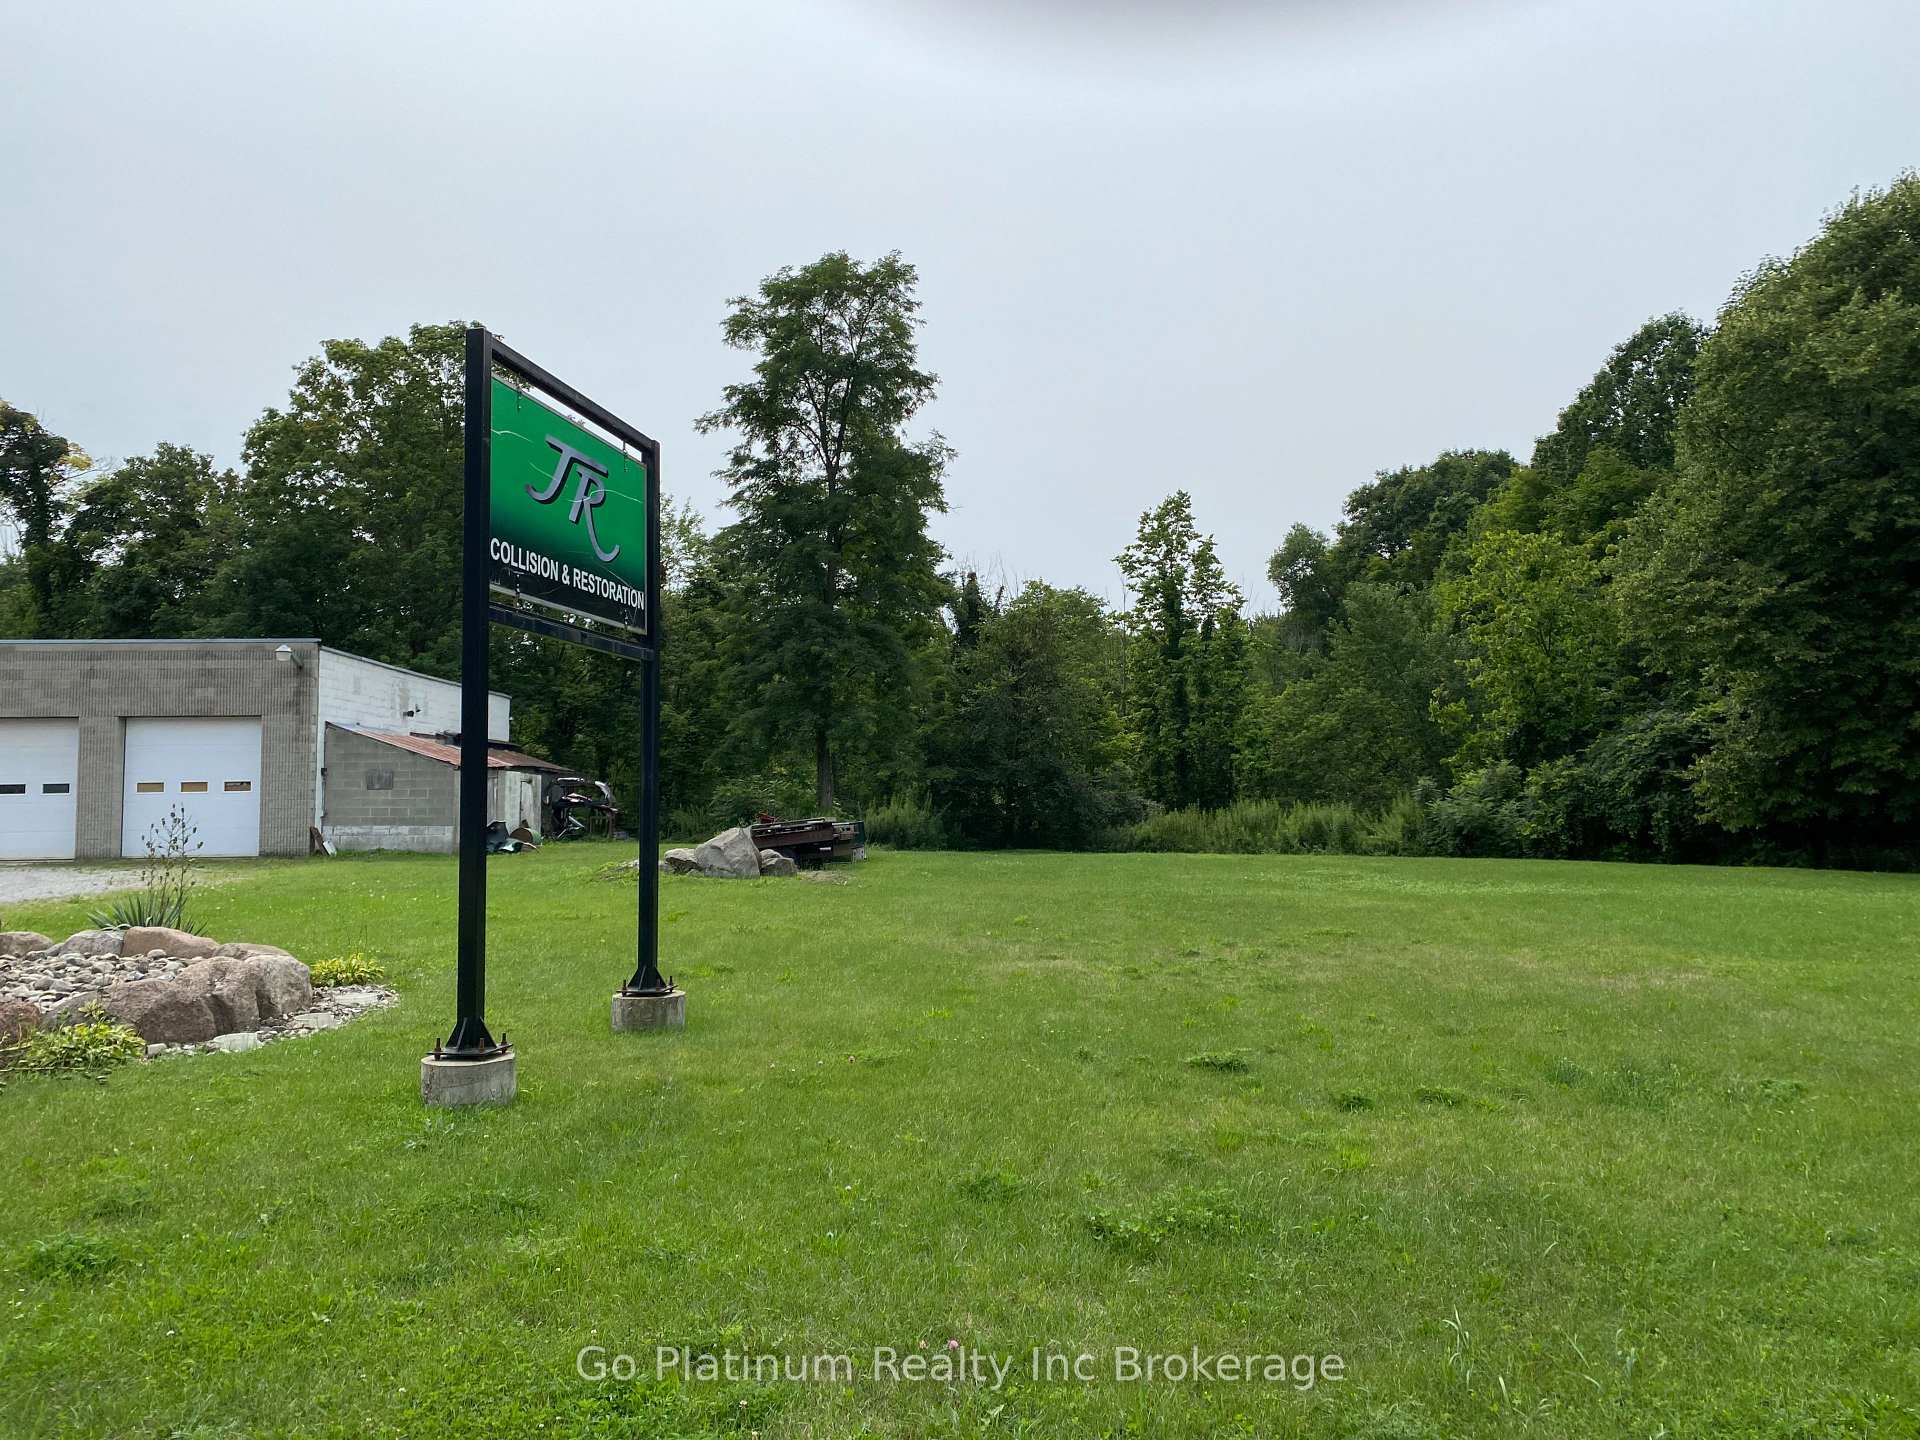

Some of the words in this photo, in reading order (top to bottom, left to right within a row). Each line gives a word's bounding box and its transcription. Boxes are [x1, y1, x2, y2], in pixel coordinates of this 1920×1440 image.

[490, 537, 559, 581] COLLISION
[561, 563, 571, 586] &
[573, 567, 645, 610] RESTORATION
